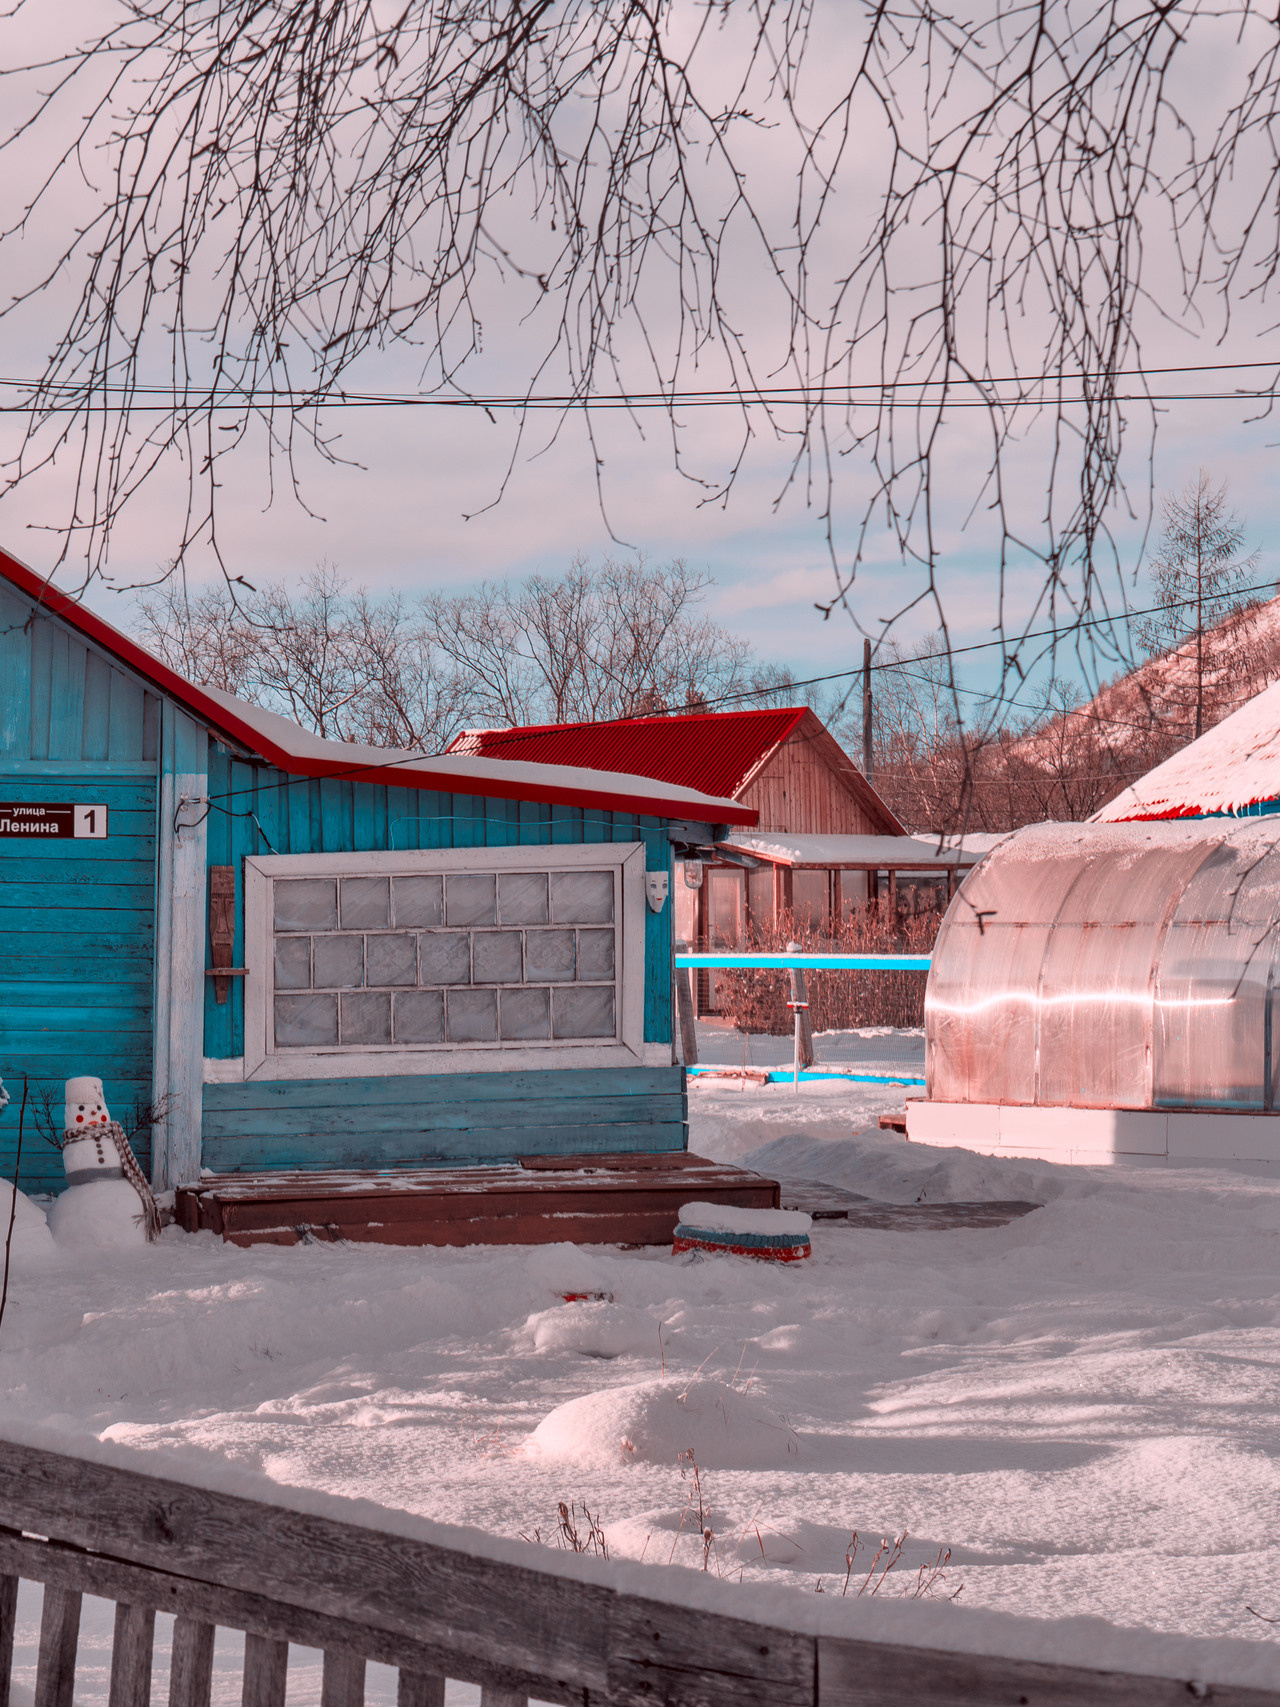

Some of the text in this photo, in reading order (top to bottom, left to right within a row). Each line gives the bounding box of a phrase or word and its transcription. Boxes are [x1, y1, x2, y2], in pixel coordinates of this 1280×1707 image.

[13, 807, 45, 817] улица
[0, 819, 59, 833] Ленина
[84, 809, 96, 833] 1
